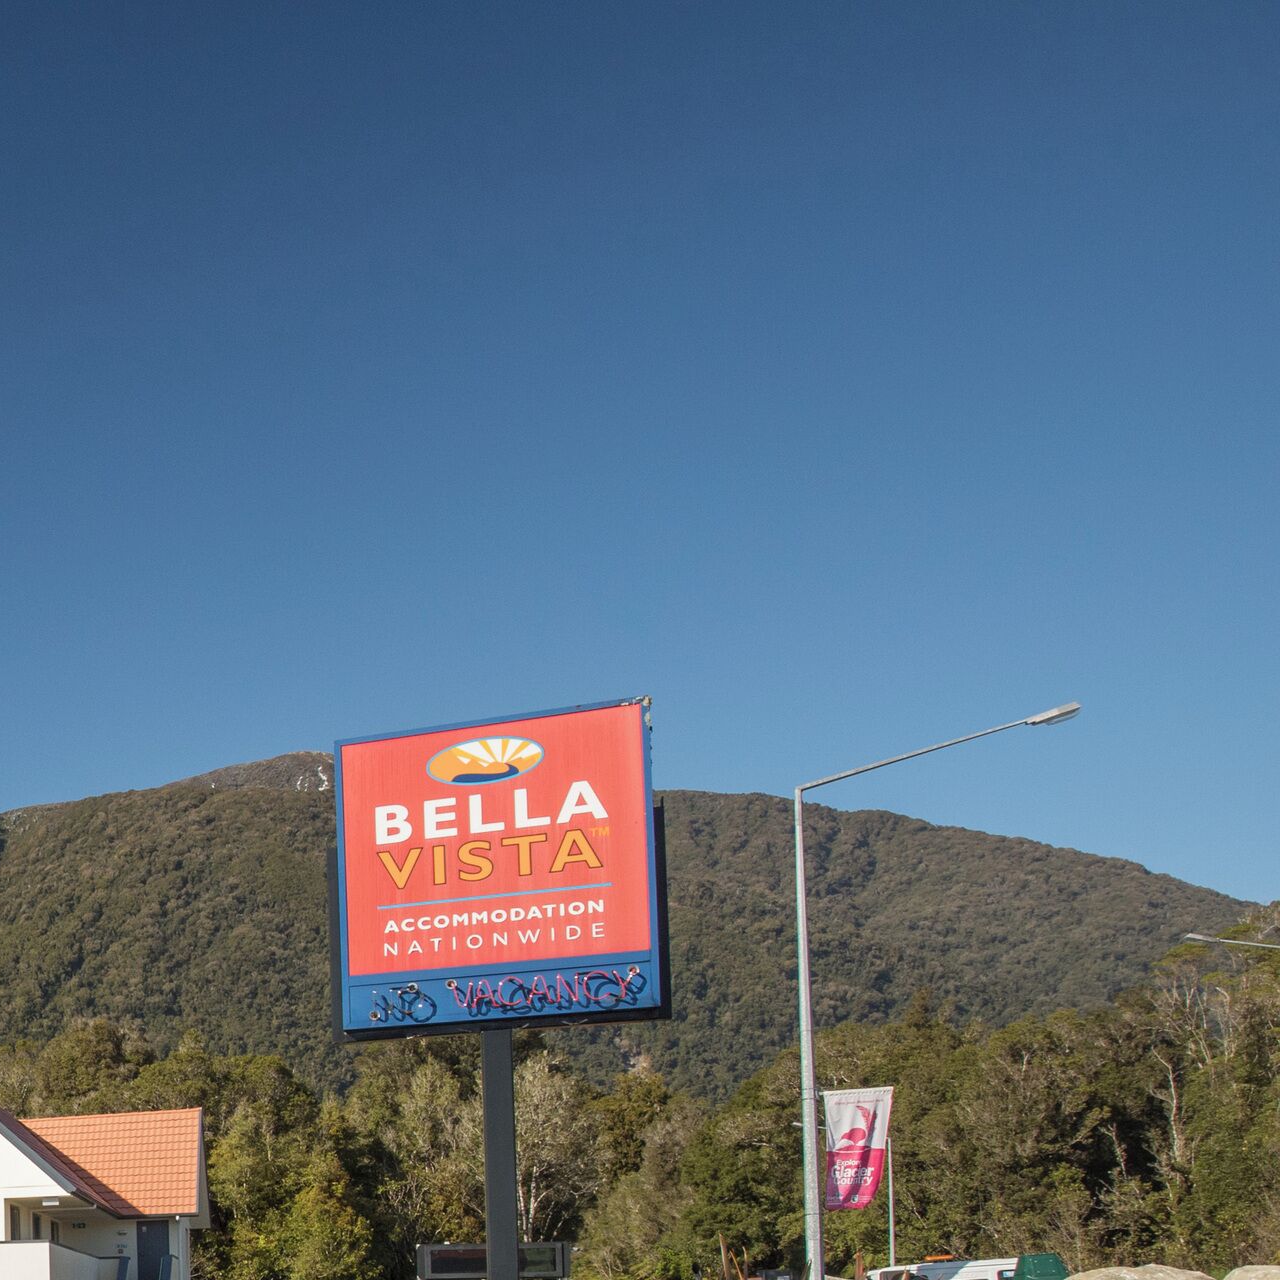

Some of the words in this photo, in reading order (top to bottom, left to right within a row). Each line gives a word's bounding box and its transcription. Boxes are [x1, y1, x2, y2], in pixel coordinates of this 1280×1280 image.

[374, 780, 609, 845] BELLA
[376, 828, 604, 890] VISTA
[383, 899, 605, 934] ACCOMMODATION
[383, 922, 605, 957] NATIONWIDE
[449, 968, 641, 1009] VACANCY
[831, 1166, 874, 1179] Glacier
